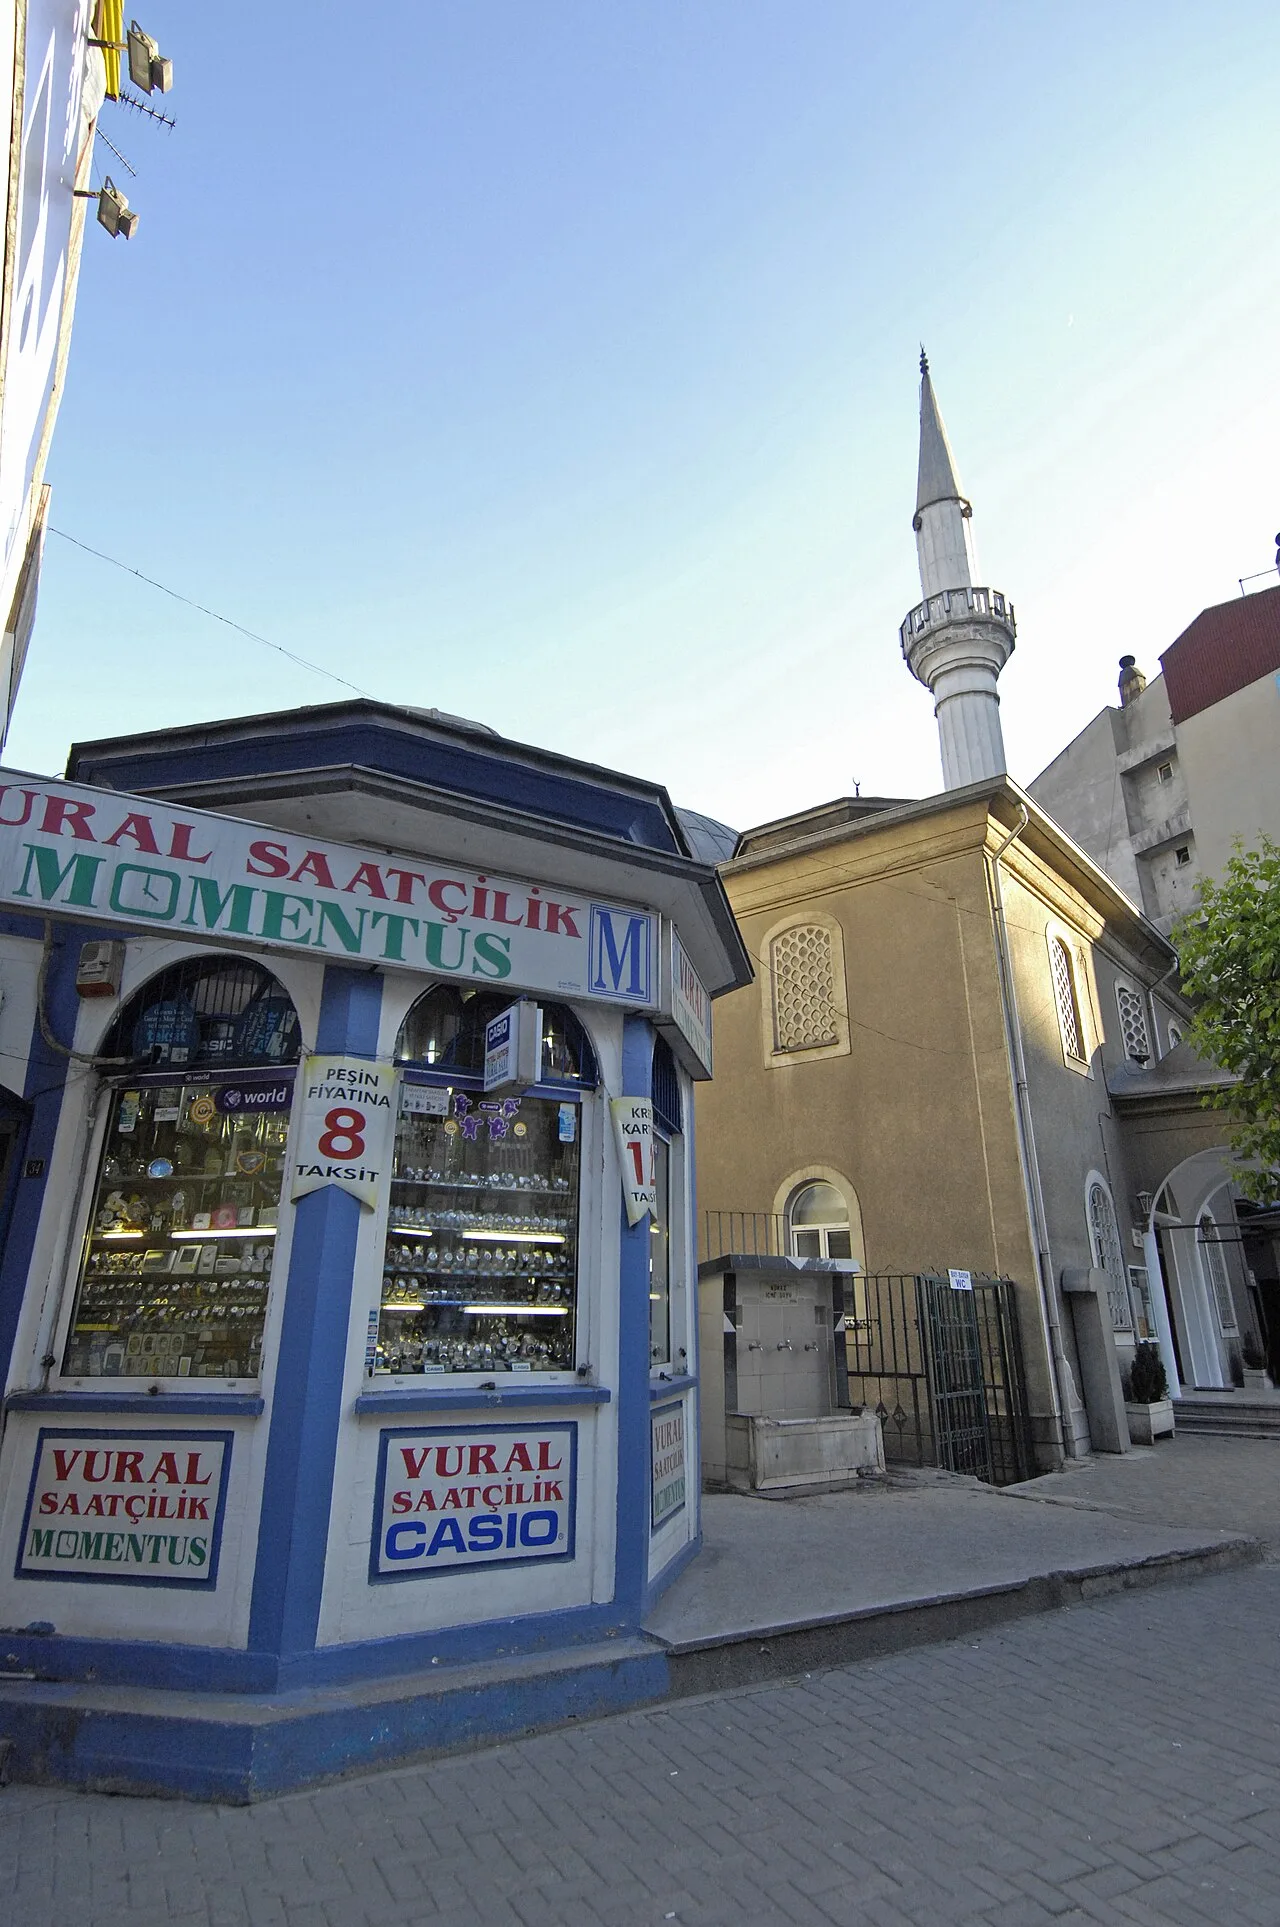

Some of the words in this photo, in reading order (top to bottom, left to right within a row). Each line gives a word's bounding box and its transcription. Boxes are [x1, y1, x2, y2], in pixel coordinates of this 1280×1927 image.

[246, 841, 582, 939] SAATÇİLİK
[12, 843, 512, 979] MOMENTUS
[594, 910, 645, 995] M
[488, 1019, 508, 1043] CASIO
[244, 1087, 287, 1104] world
[327, 1068, 379, 1087] PEŞİN
[308, 1084, 390, 1108] FİYATINA
[318, 1107, 366, 1160] 8
[296, 1164, 379, 1182] TAKSİT
[956, 1279, 966, 1288] WC
[654, 1418, 684, 1452] VURAL
[53, 1450, 213, 1485] VURAL
[400, 1441, 563, 1479] VURAL
[39, 1488, 211, 1524] SAATÇİLİK
[392, 1474, 564, 1514] SAATÇİLİK
[28, 1528, 208, 1567] MOMENTUS
[385, 1510, 559, 1560] CASIO
